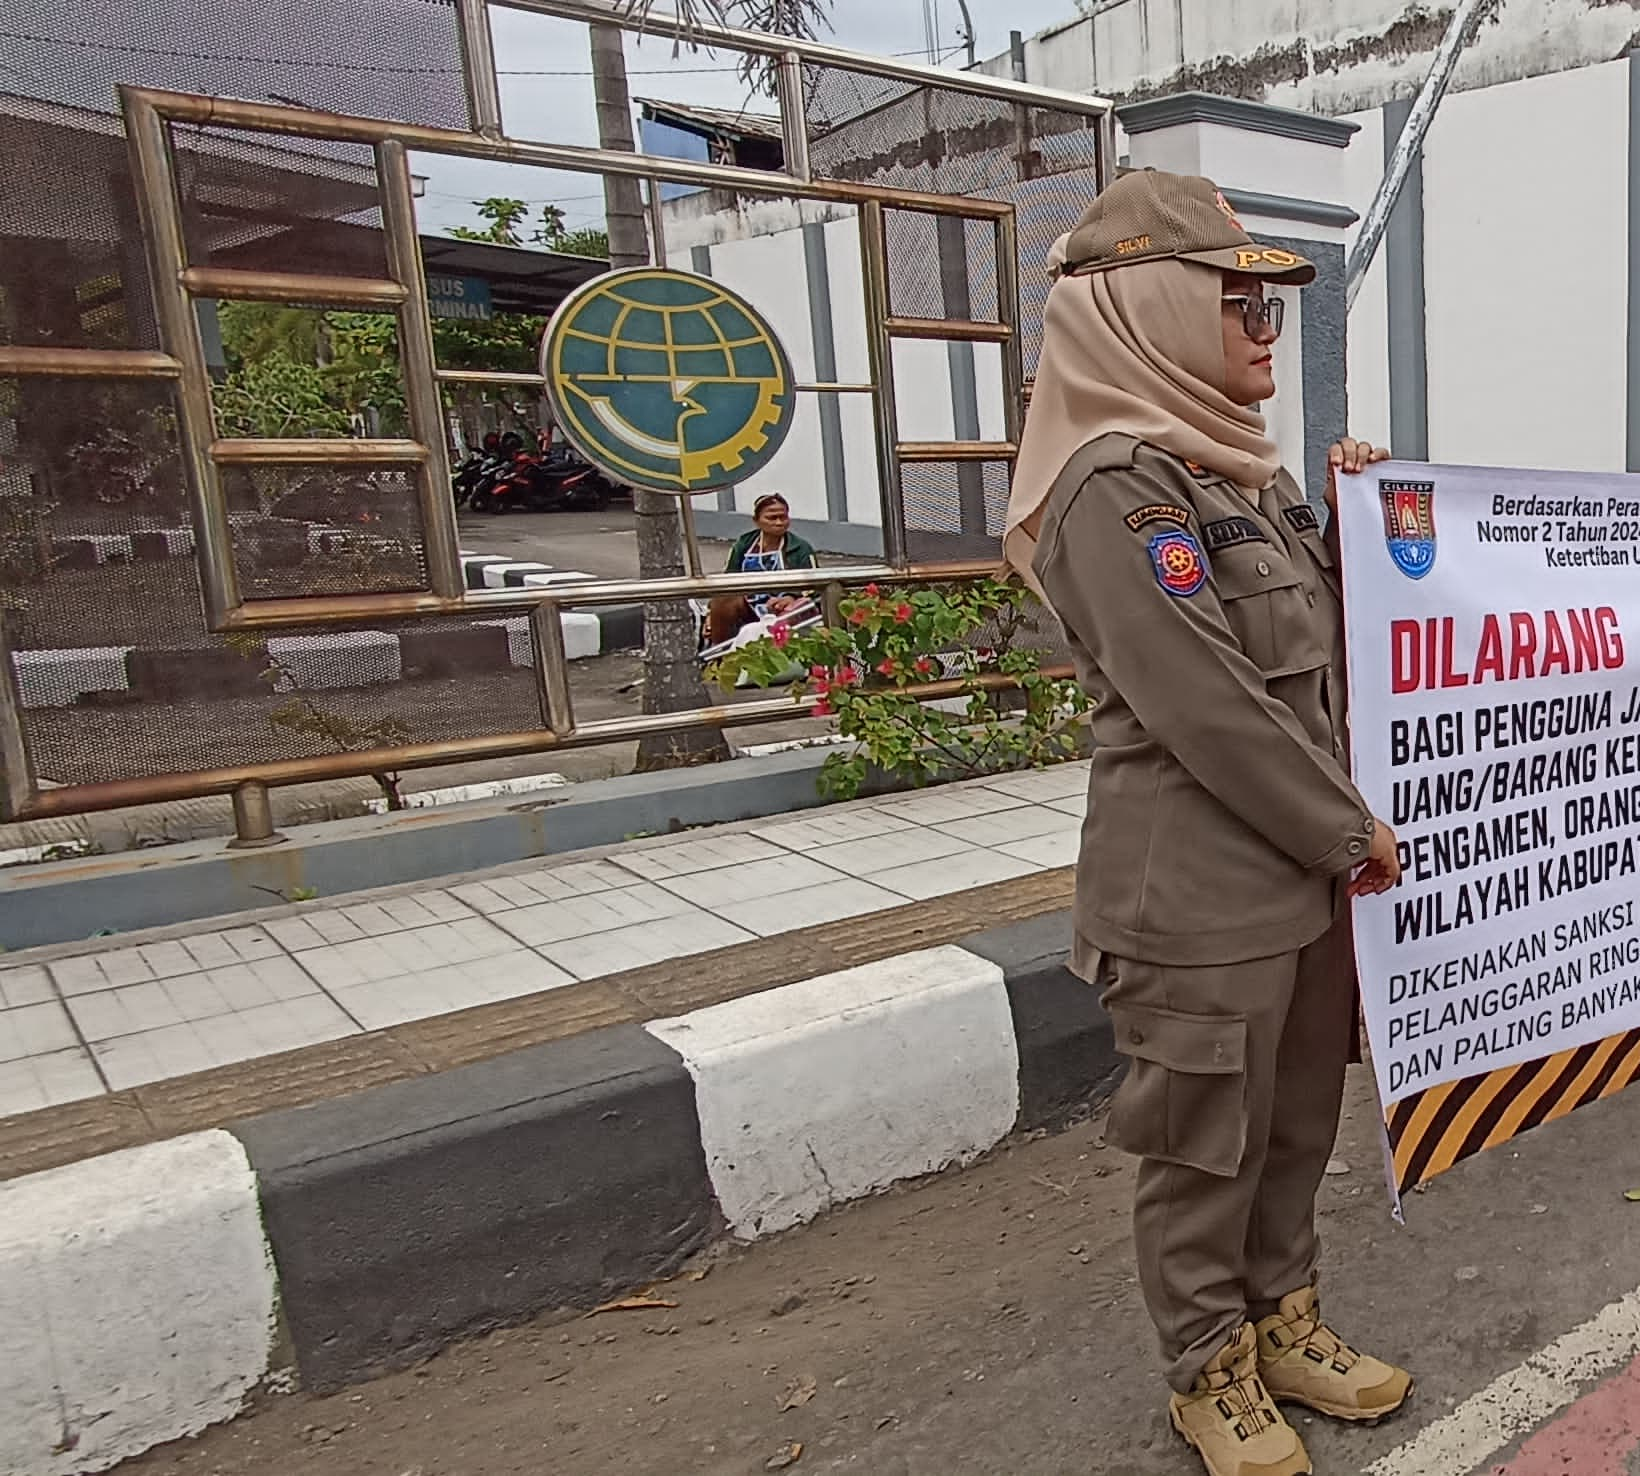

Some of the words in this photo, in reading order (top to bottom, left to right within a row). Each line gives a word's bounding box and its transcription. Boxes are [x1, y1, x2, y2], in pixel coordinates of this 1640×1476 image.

[429, 278, 464, 297] SUS
[1236, 249, 1304, 268] PO
[1384, 483, 1430, 491] CILACAP
[1492, 494, 1603, 517] Berdasarkan
[1477, 520, 1538, 542] Nomor
[1542, 521, 1552, 542] 2
[1556, 520, 1608, 542] Tahun
[1545, 545, 1629, 567] Ketertiban
[1391, 605, 1624, 695] DILARANG
[1391, 712, 1463, 767] BAGI
[1475, 690, 1612, 752] PENGGUNA
[1392, 743, 1597, 827] UANG/BARANG
[1396, 806, 1555, 887] PENGAMEN,
[1394, 866, 1529, 945] WILAYAH
[1390, 931, 1546, 1004] DIKENAKAN
[1554, 903, 1634, 952] SANKSI
[1388, 963, 1582, 1048] PELANGGARAN
[1390, 1044, 1444, 1092] DAN
[1453, 1009, 1553, 1066] PALING
